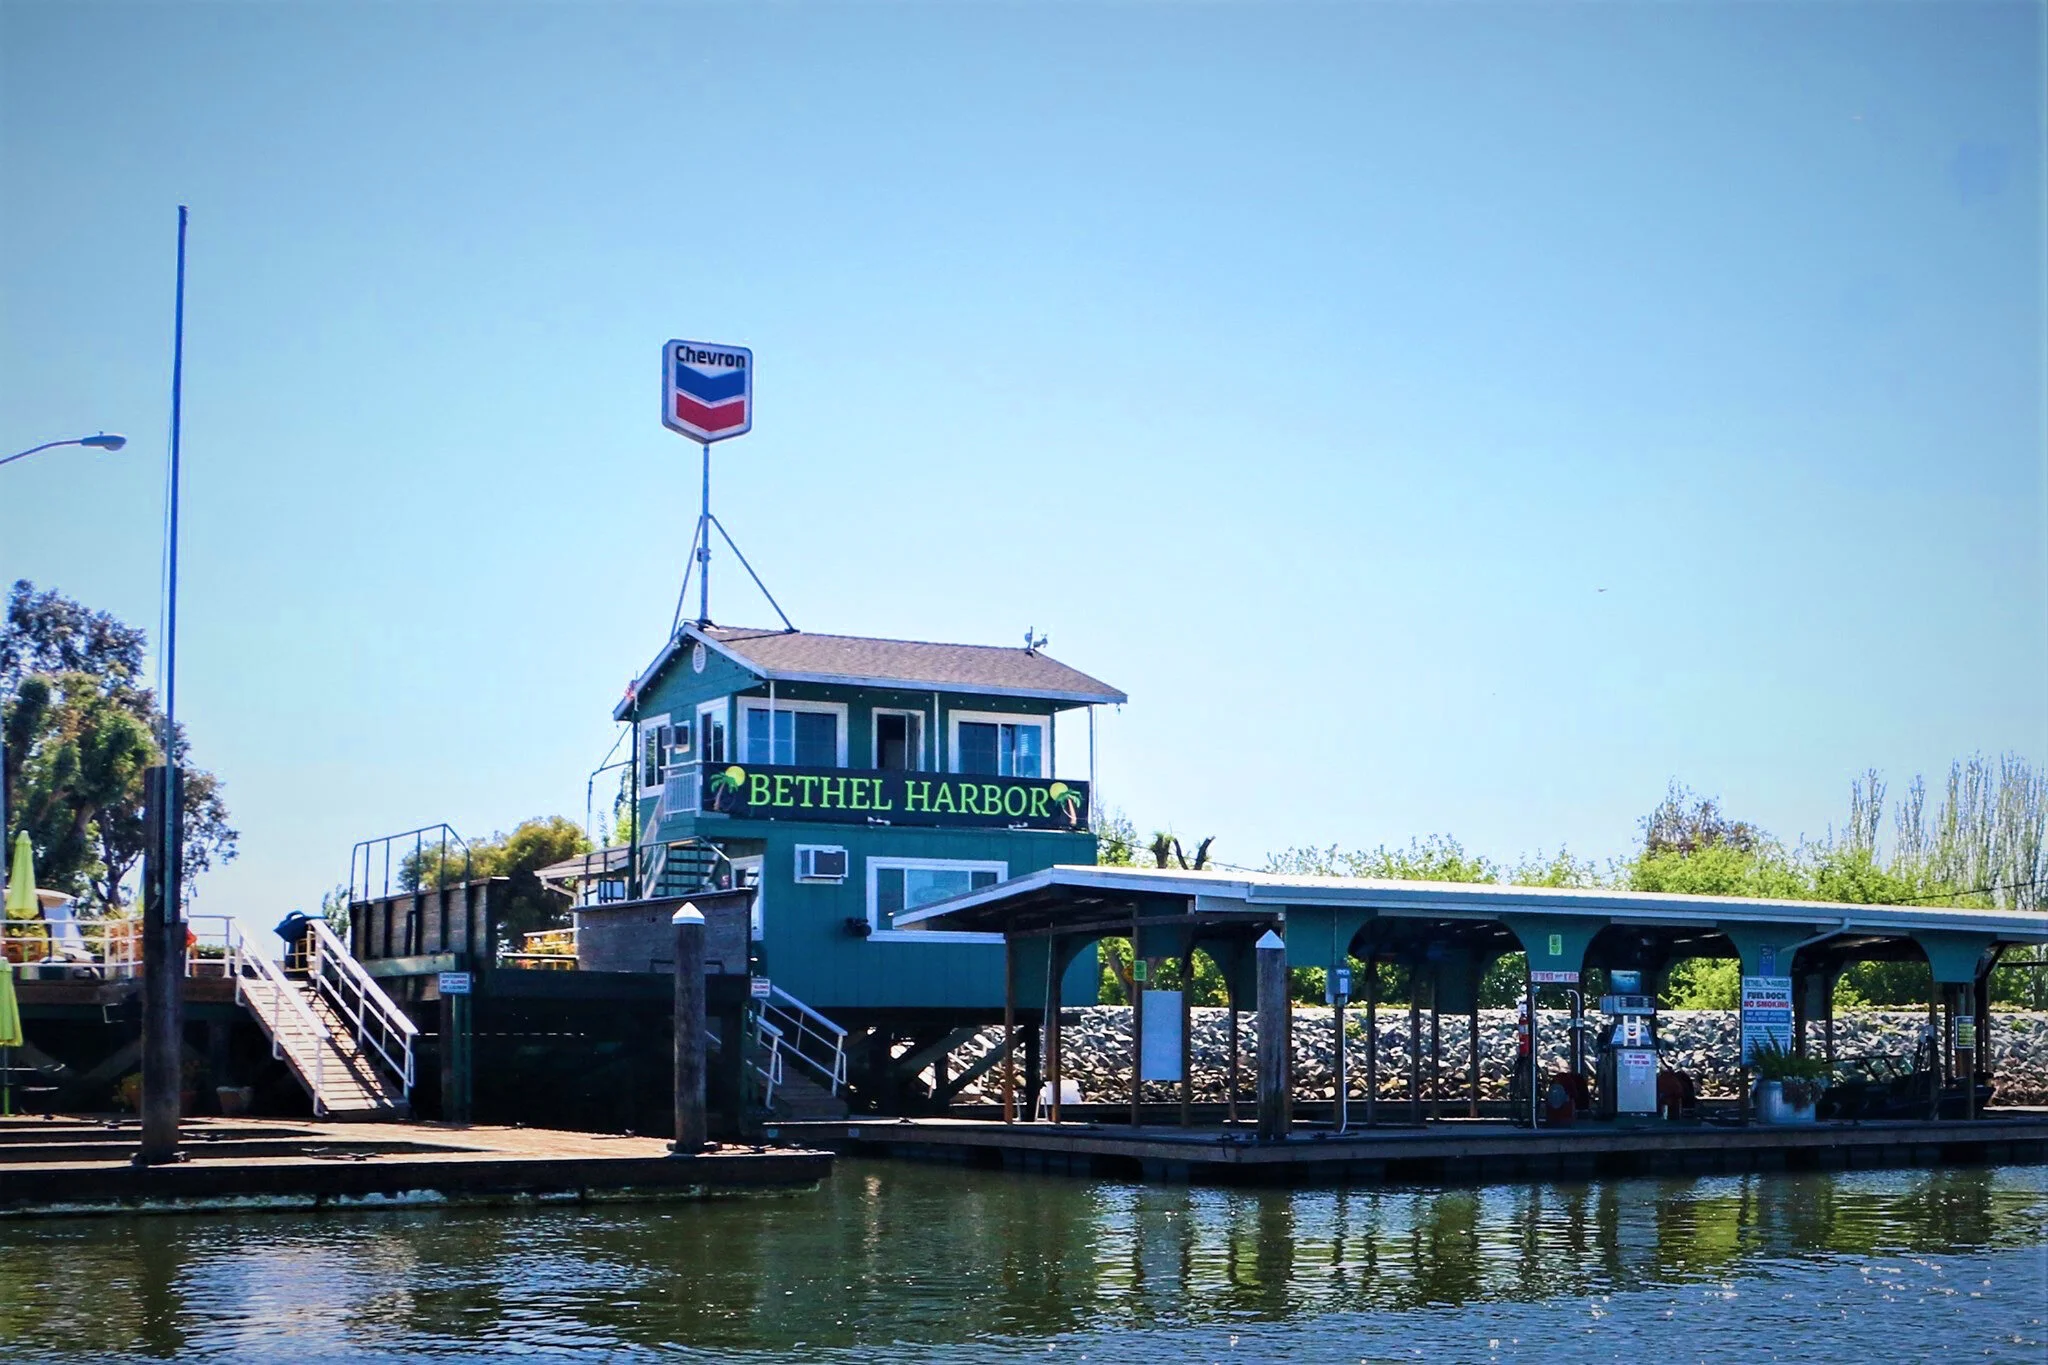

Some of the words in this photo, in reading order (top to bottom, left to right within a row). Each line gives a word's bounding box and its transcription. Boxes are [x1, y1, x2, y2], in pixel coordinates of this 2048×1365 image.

[675, 345, 746, 368] Chevron
[747, 773, 892, 812] BETHEL
[904, 780, 1051, 818] HARBOR
[1766, 992, 1787, 1000] DOCK
[1744, 1000, 1755, 1008] NO
